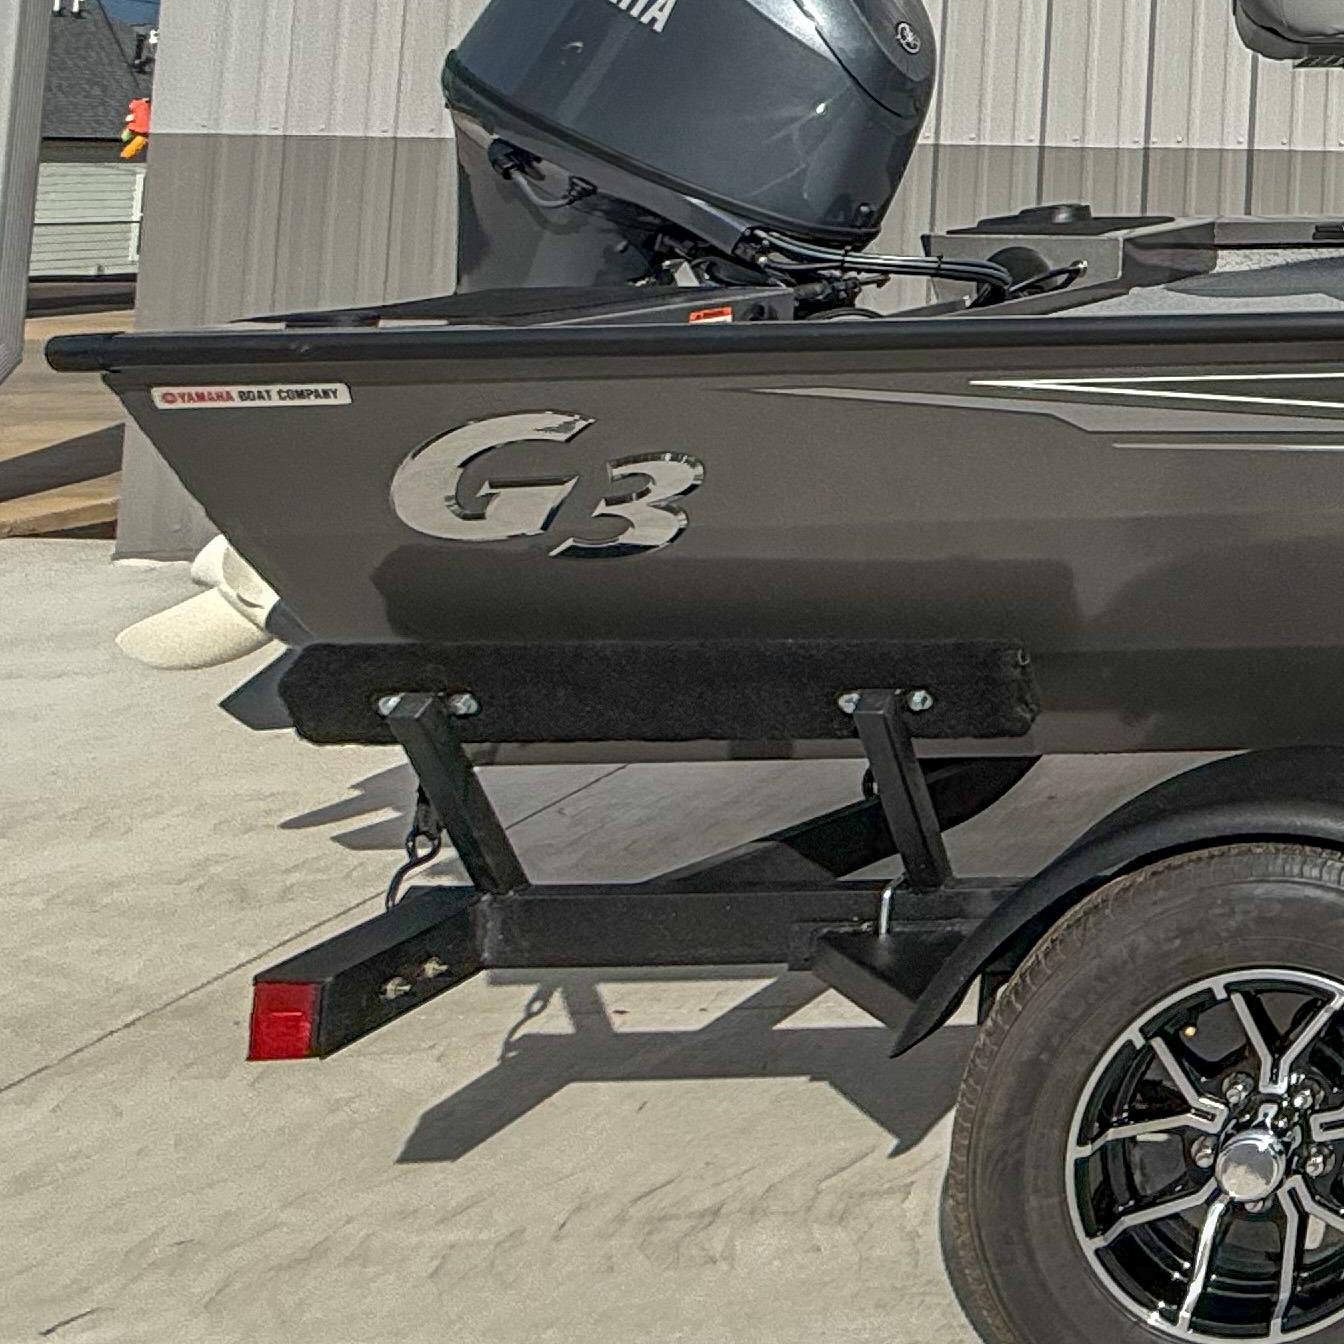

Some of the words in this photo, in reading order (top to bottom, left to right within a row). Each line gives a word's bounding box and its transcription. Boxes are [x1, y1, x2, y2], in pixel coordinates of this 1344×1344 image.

[179, 391, 235, 404] YAMAHA
[237, 389, 273, 402] BOAT
[277, 388, 339, 401] COMPANY
[390, 409, 706, 558] G3
